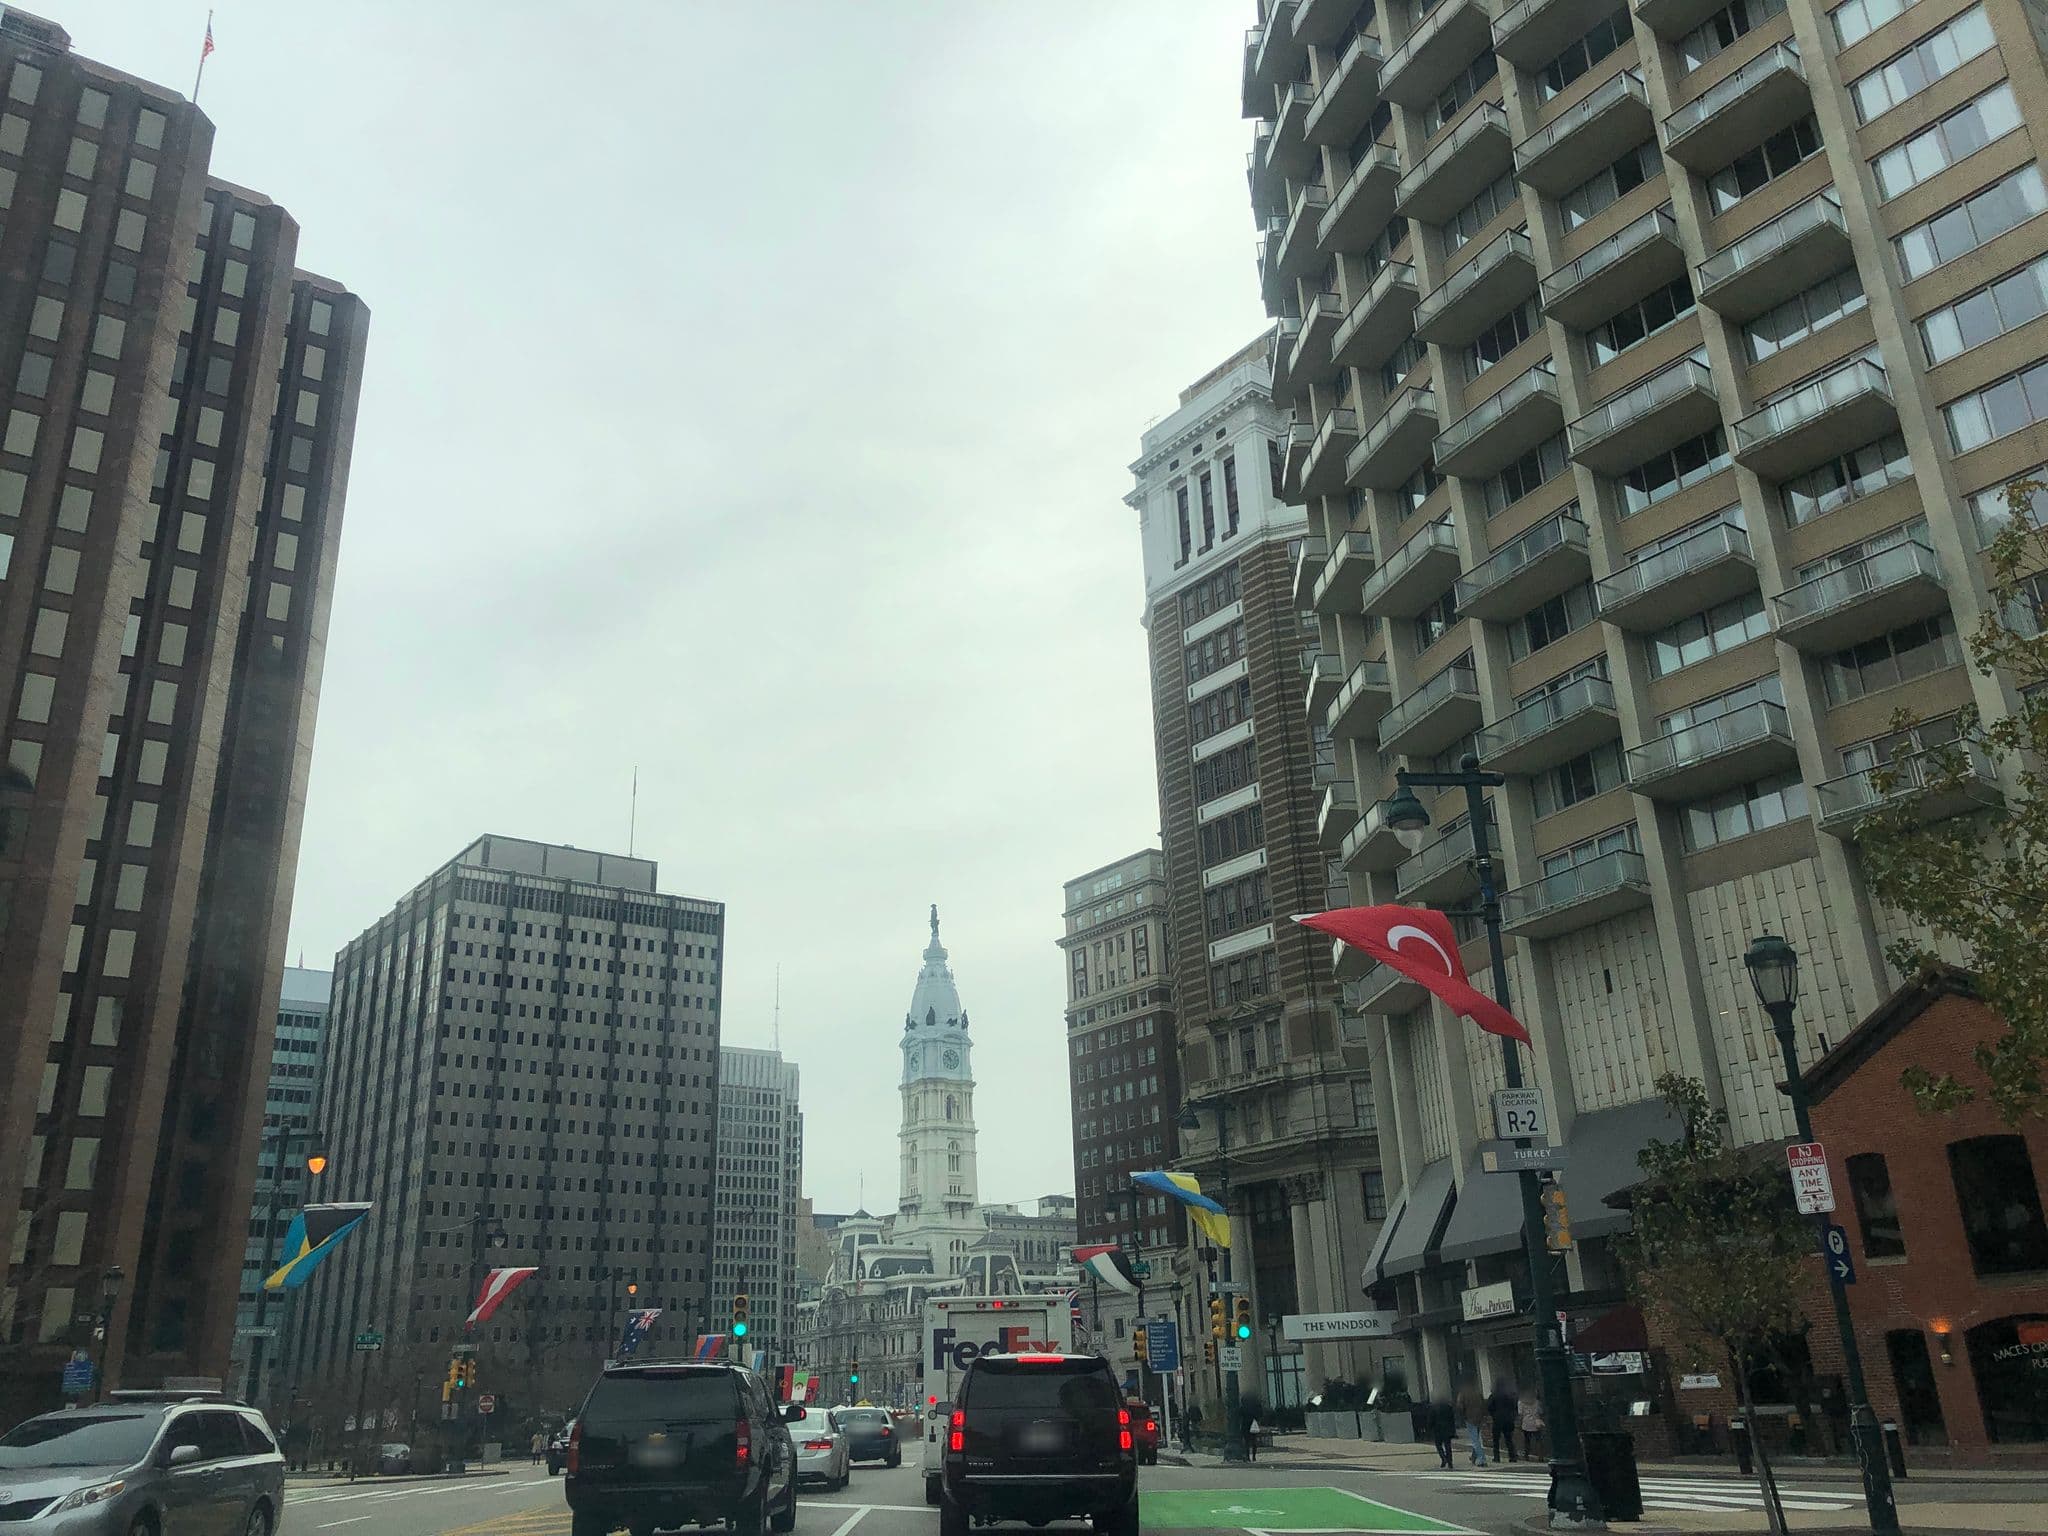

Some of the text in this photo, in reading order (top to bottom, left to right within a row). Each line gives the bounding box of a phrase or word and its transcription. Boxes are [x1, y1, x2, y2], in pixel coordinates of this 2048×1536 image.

[1502, 1092, 1535, 1100] PARKWAY
[1507, 1110, 1538, 1133] R-2
[1514, 1149, 1552, 1159] TURKEY
[1798, 1147, 1812, 1158] NO
[1791, 1156, 1824, 1167] STOPPING
[1798, 1168, 1820, 1178] ANY
[1799, 1178, 1823, 1188] TIME
[1832, 1235, 1840, 1250] P
[1303, 1318, 1380, 1332] THE WINDSOR
